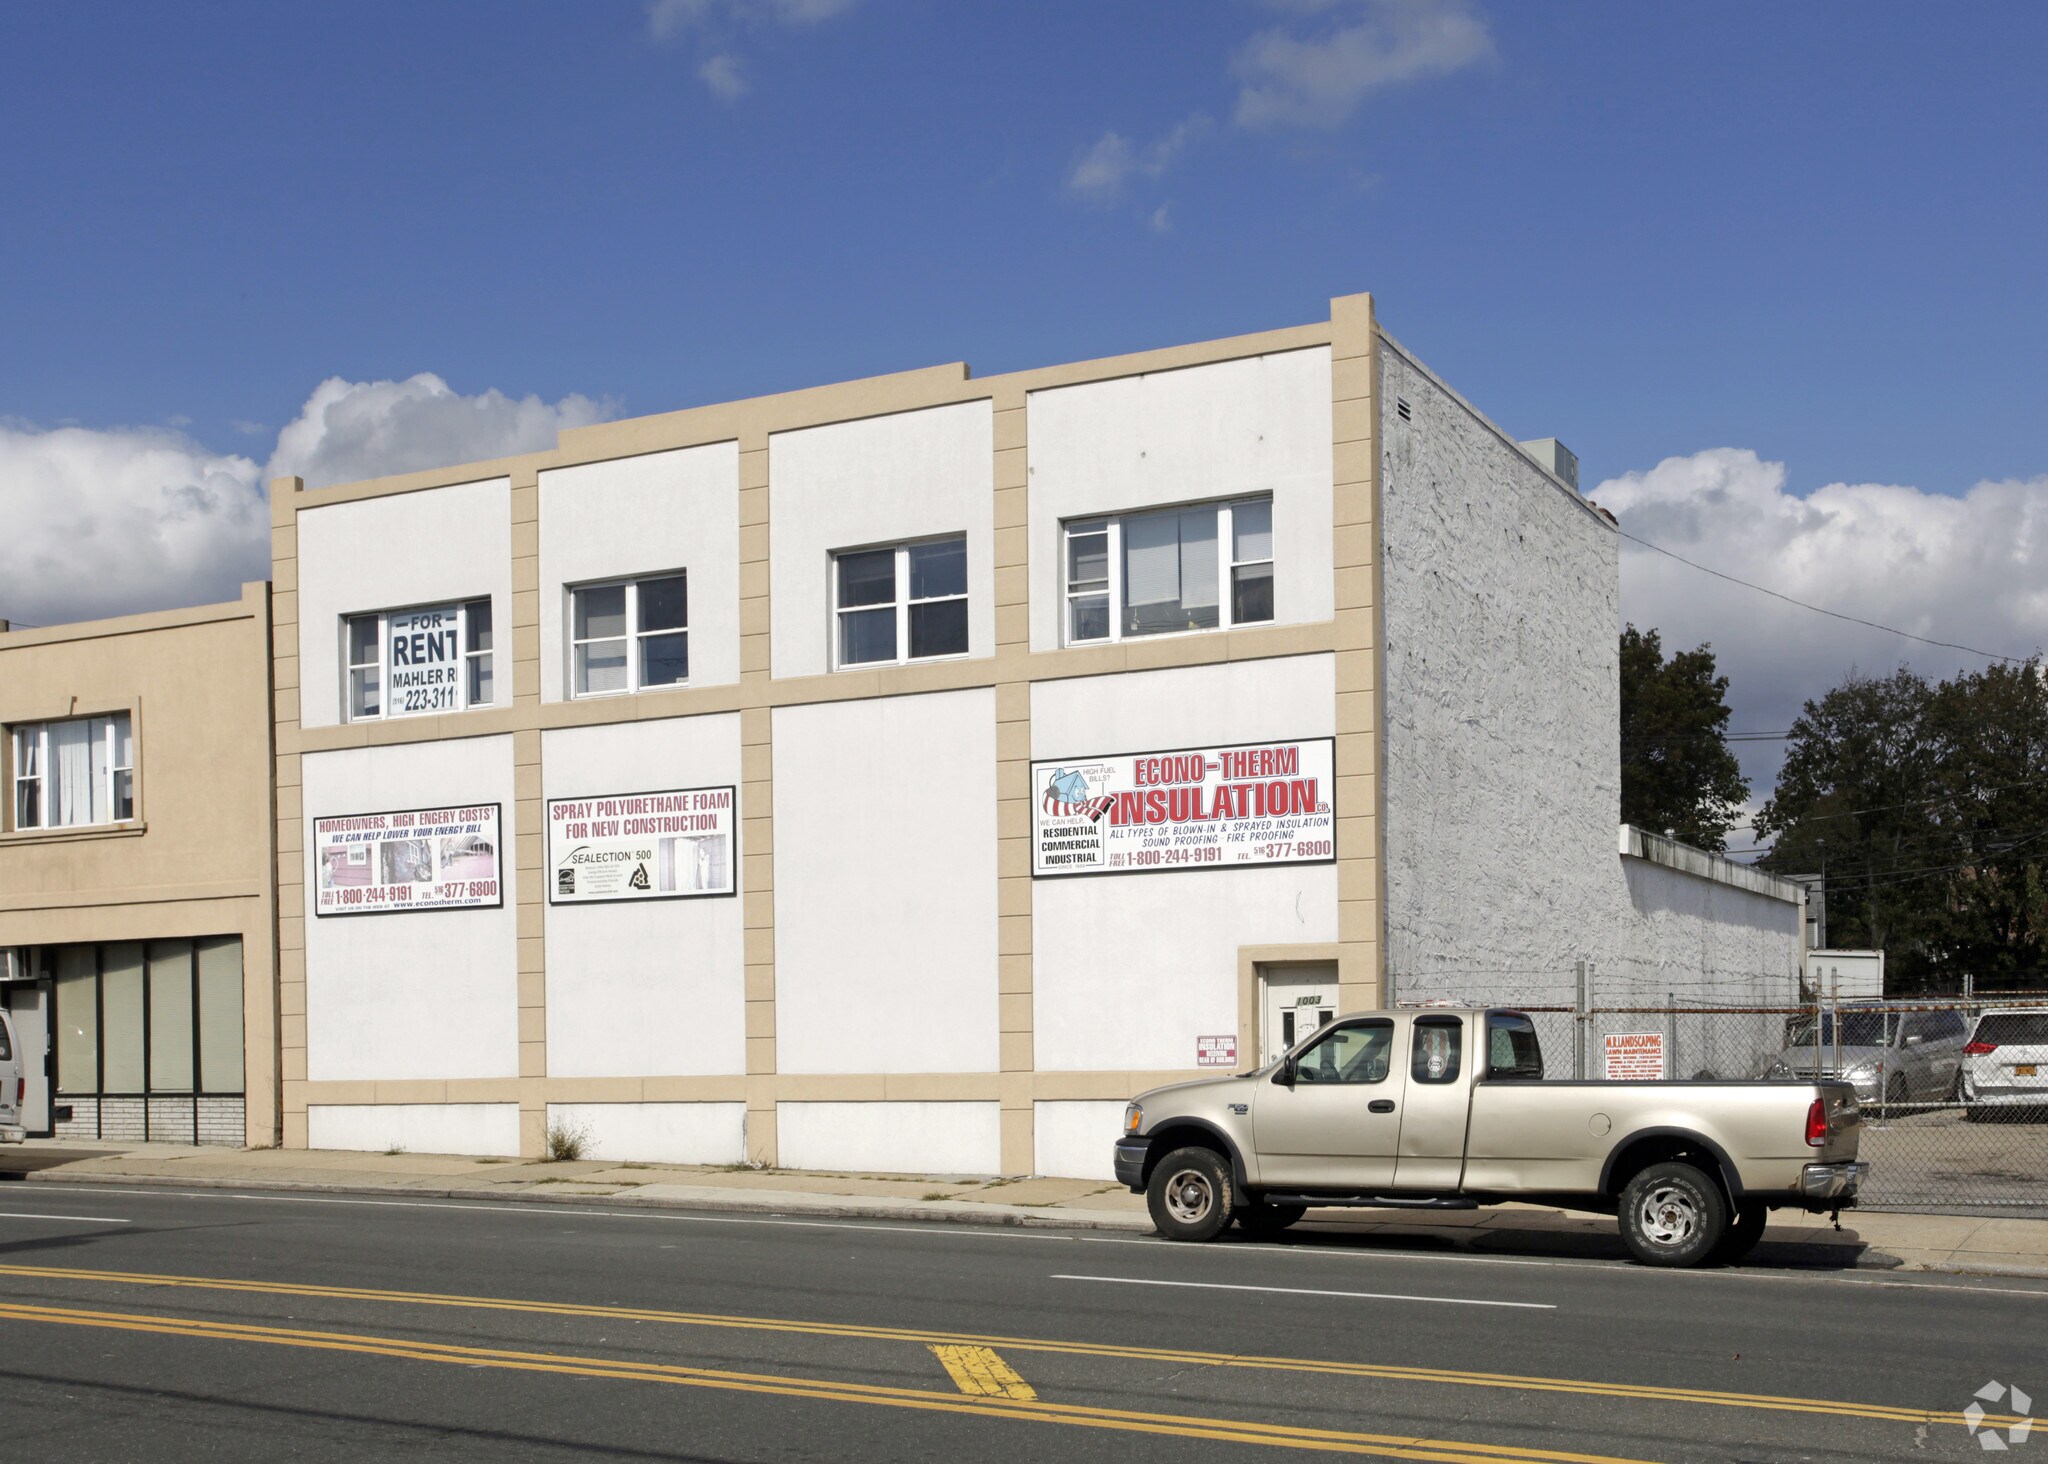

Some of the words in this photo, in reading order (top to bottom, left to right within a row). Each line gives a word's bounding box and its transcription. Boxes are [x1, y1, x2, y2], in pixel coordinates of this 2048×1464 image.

[411, 613, 442, 631] FOR
[393, 669, 443, 688] MAHLER
[448, 667, 458, 682] R
[405, 686, 458, 711] 223-311
[1134, 746, 1298, 786] ECONO-THERM
[553, 803, 592, 821] SPRAY
[597, 795, 689, 817] POLYURETHANE
[693, 792, 730, 810] FOAM
[1109, 778, 1317, 826] INSULATION
[319, 816, 389, 833] HOMEOWNERS,
[393, 814, 415, 827] HIGH
[419, 811, 455, 825] ENGERY
[459, 807, 494, 822] COSTS?
[566, 823, 588, 839] FOR
[592, 820, 619, 837] NEW
[624, 814, 717, 835] CONSTRUCTION
[1110, 830, 1124, 839] ALL
[1128, 828, 1154, 838] TYPES
[1158, 827, 1169, 836] OF
[1173, 824, 1216, 835] BLOWN-IN
[1220, 824, 1227, 832] &
[1233, 820, 1272, 832] SPRAYED
[1276, 817, 1329, 829] INSULATION
[332, 834, 344, 843] WE
[346, 833, 361, 842] CAN
[363, 832, 381, 841] HELP
[383, 829, 409, 839] LOWER
[413, 828, 433, 837] YOUR
[435, 825, 464, 836] ENERGY
[466, 824, 481, 833] BILL
[1043, 825, 1098, 838] RESIDENTIAL
[1142, 838, 1170, 847] SOUND
[1175, 835, 1218, 845] PROOFING
[1227, 832, 1245, 842] FIRE
[1250, 830, 1294, 841] PROOFING
[1041, 839, 1100, 852] COMMERCIAL
[1126, 847, 1221, 866] 1-800-244-9191
[1254, 846, 1265, 855] 516
[1266, 840, 1331, 858] 377-6800
[572, 851, 631, 864] SEALECTION
[636, 850, 651, 860] 500
[1045, 853, 1097, 864] INDUSTRIAL
[435, 886, 443, 894] 516
[393, 898, 481, 908] www.econotherm.com
[1298, 996, 1321, 1005] 1003
